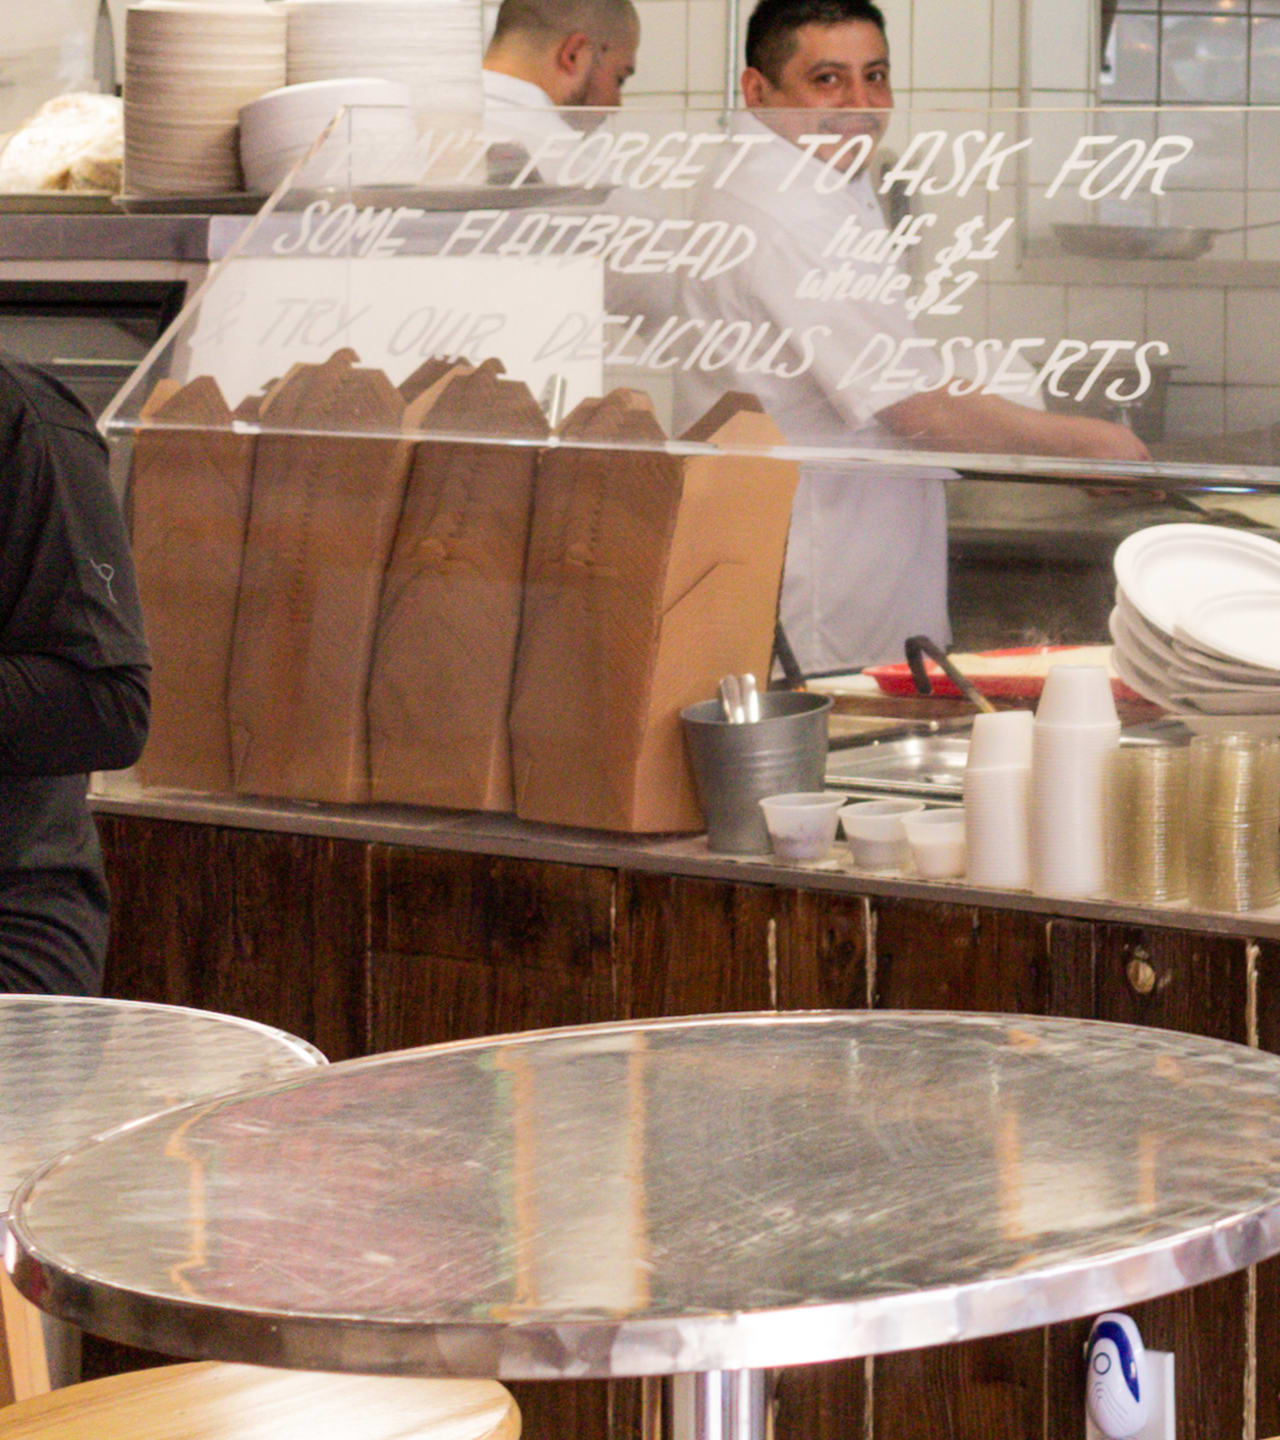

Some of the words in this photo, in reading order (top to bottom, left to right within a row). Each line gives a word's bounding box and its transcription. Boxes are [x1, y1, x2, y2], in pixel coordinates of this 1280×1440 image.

[510, 131, 779, 189] FORGET
[779, 132, 873, 194] TO
[880, 130, 1032, 197] ASK
[1045, 134, 1195, 201] FOR
[273, 200, 424, 258] SOME
[439, 208, 757, 281] FLATBREAD
[821, 213, 938, 266] half
[935, 216, 1016, 264] $1
[794, 263, 910, 306] whole
[905, 262, 979, 320] $2
[205, 289, 247, 347] &
[259, 297, 373, 349] TRY
[388, 306, 506, 359] OUR
[533, 310, 831, 379] DELICIOUS
[837, 336, 1170, 403] DESSERTS
